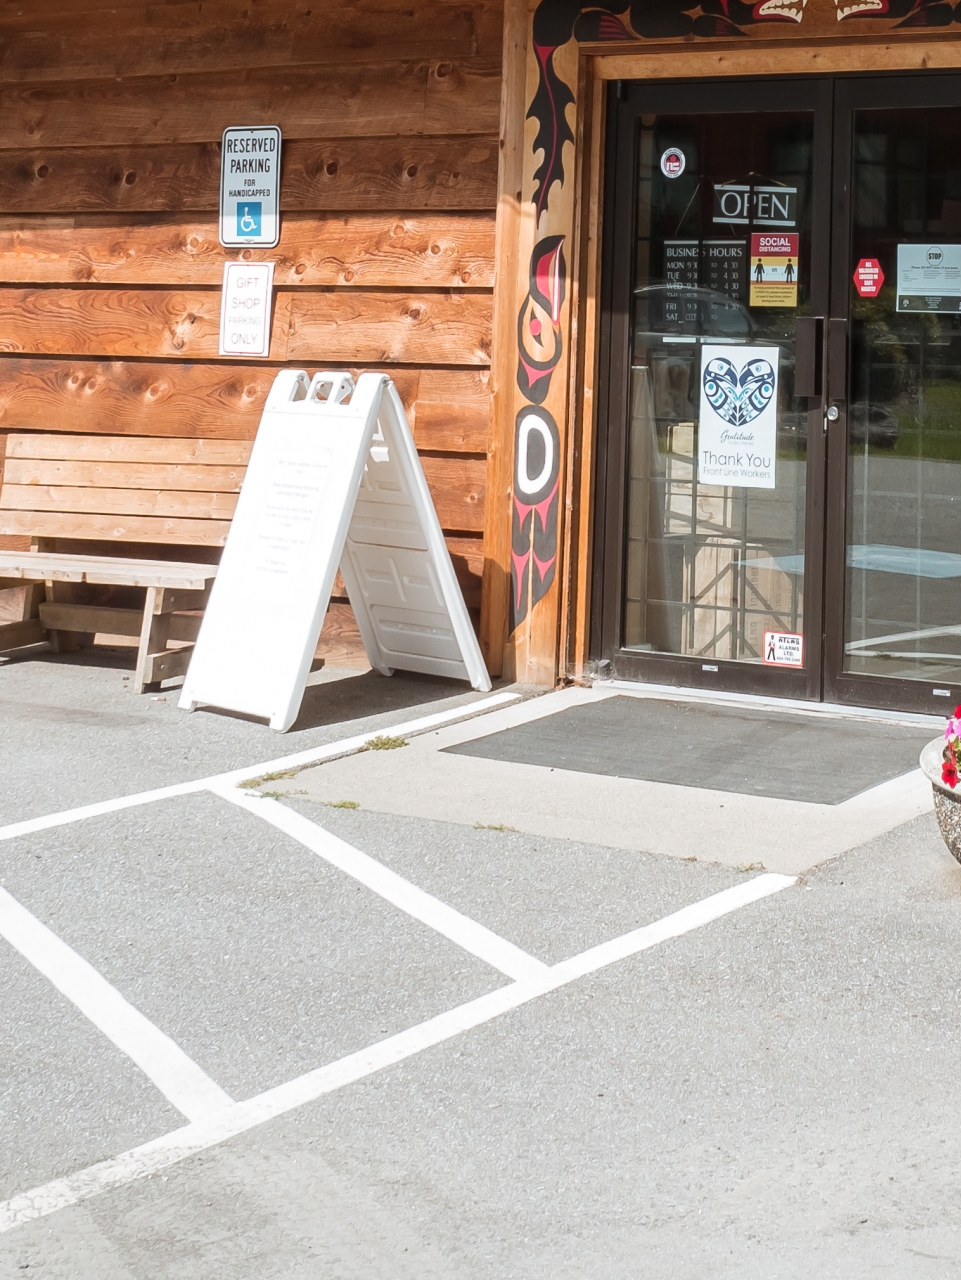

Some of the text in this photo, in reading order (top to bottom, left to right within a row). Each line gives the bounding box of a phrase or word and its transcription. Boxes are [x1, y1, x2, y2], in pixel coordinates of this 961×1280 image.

[226, 137, 276, 154] RESERVED
[230, 158, 271, 174] PARKING
[243, 179, 256, 187] FOR
[228, 188, 271, 198] HANDICAPPED
[720, 191, 790, 219] OPEN
[759, 237, 791, 246] SOCIAL
[666, 247, 743, 257] BUSINES HOURS
[928, 252, 942, 260] STOP
[666, 261, 685, 269] MON
[236, 277, 260, 289] GIFT
[231, 297, 261, 310] SHOP
[228, 315, 262, 326] PARKING
[666, 313, 679, 321] SAT
[230, 332, 258, 345] ONLY
[720, 429, 755, 443] Gratitude
[702, 450, 771, 469] Thank You
[703, 466, 771, 479] Front Line Workers
[778, 636, 800, 645] ATLAS
[778, 644, 800, 652] ALARMS
